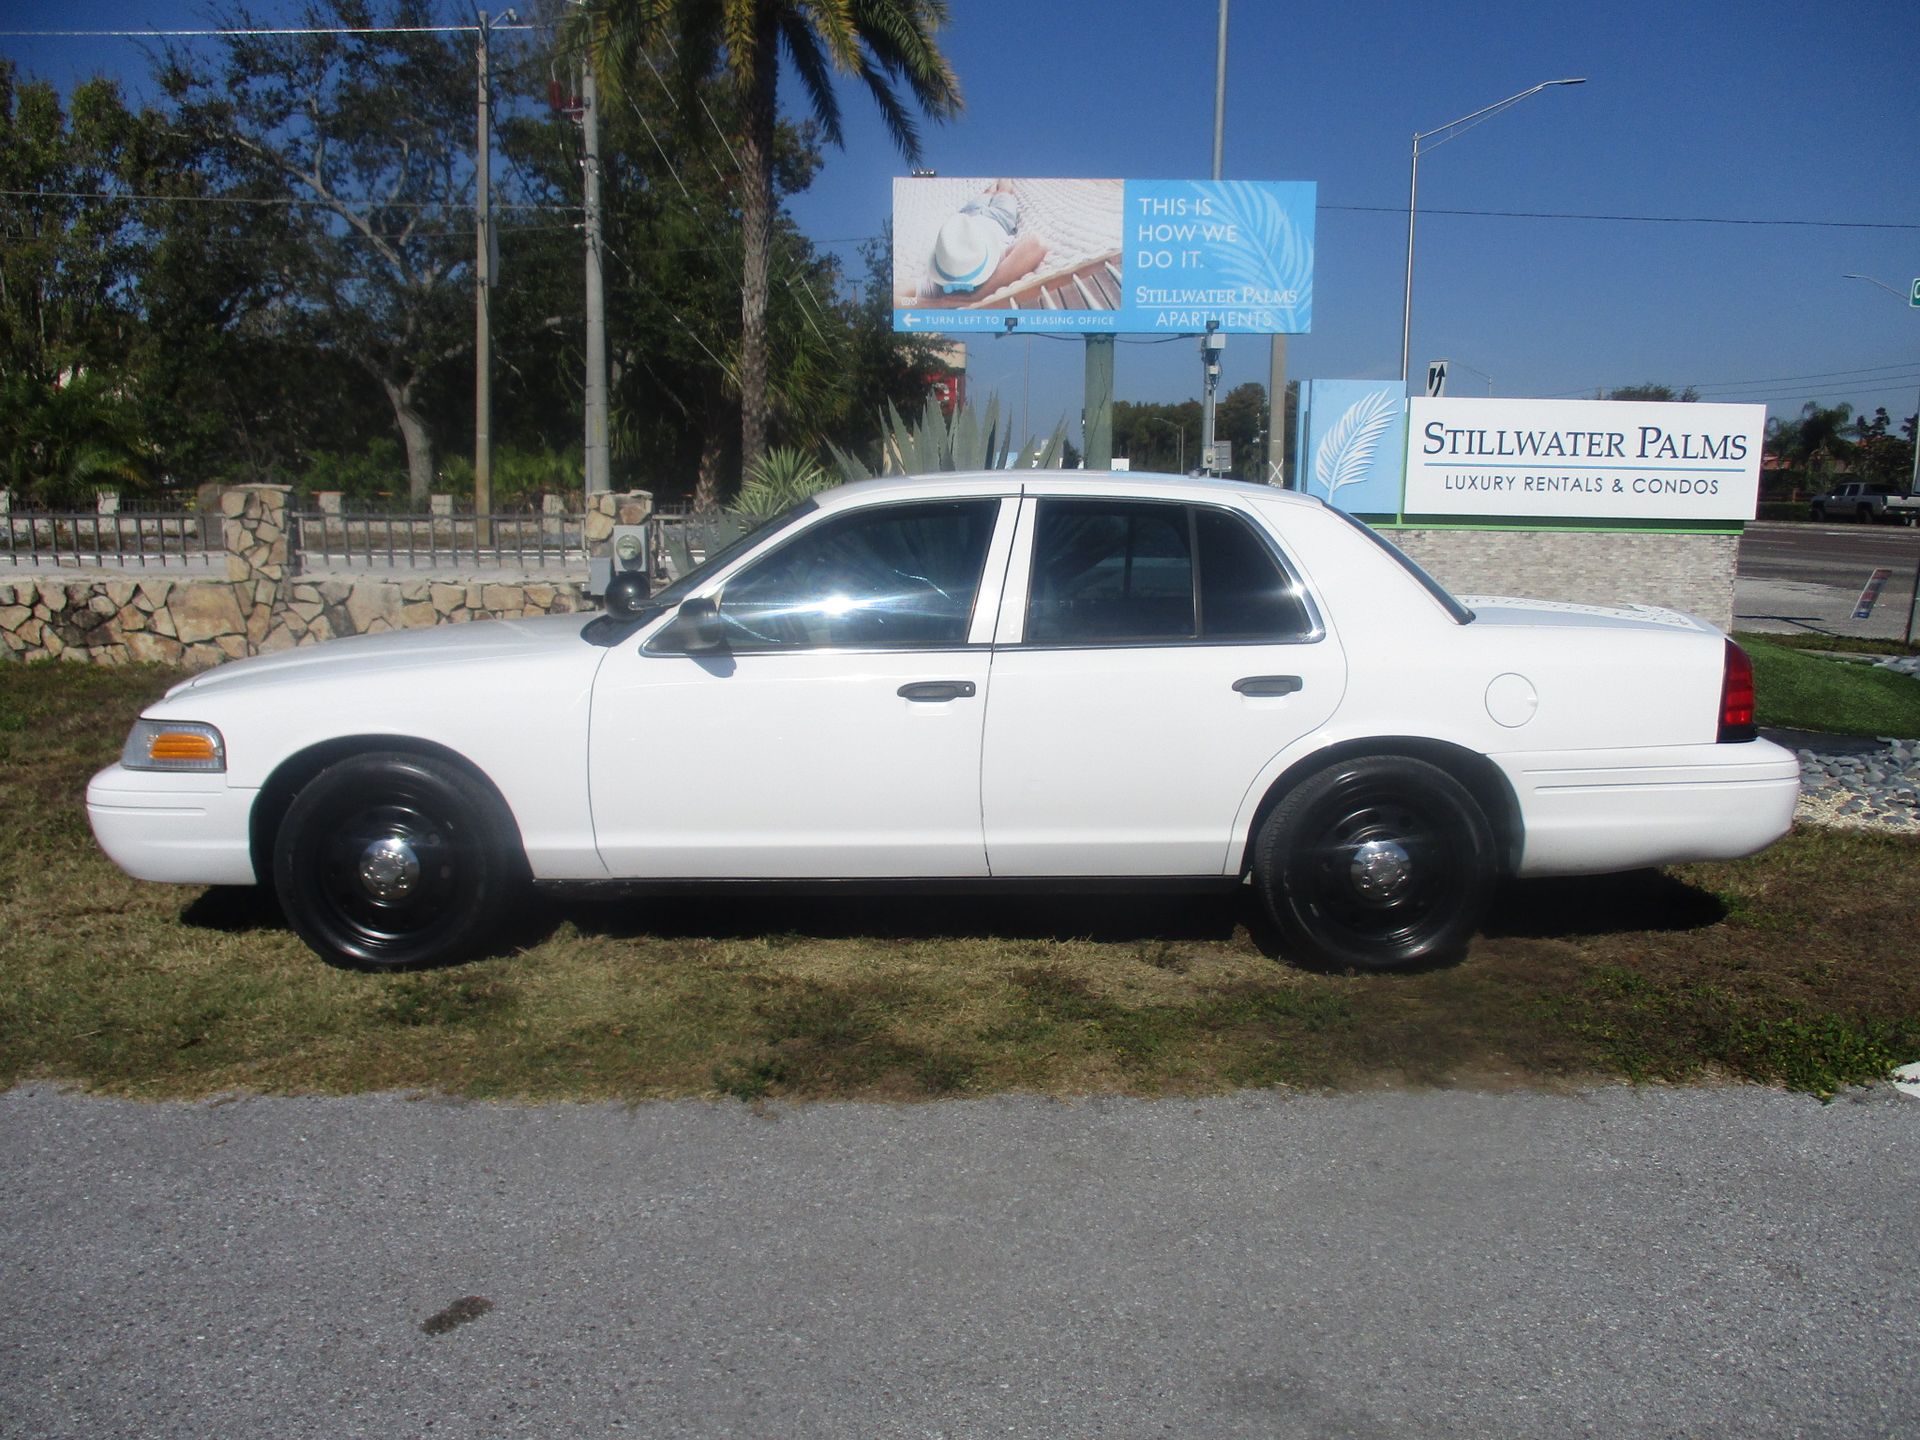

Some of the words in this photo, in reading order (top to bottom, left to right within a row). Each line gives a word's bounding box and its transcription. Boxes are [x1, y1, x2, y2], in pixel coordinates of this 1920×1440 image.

[1139, 198, 1187, 216] THIS
[1195, 198, 1212, 216] IS
[1138, 224, 1197, 242] HOW
[1202, 224, 1237, 242] WE
[1138, 250, 1173, 268] DO
[1181, 250, 1205, 268] IT.
[925, 316, 954, 325] TURN
[958, 316, 981, 325] LEFT
[985, 316, 999, 325] TO
[1030, 316, 1074, 325] LEASING
[1078, 316, 1115, 326] OFFICE
[1155, 311, 1273, 327] APARTMENTS
[1445, 475, 1516, 491] LUXURY
[1524, 476, 1603, 493] RENTALS
[1612, 479, 1624, 493] &
[1632, 478, 1719, 495] CONDOS
